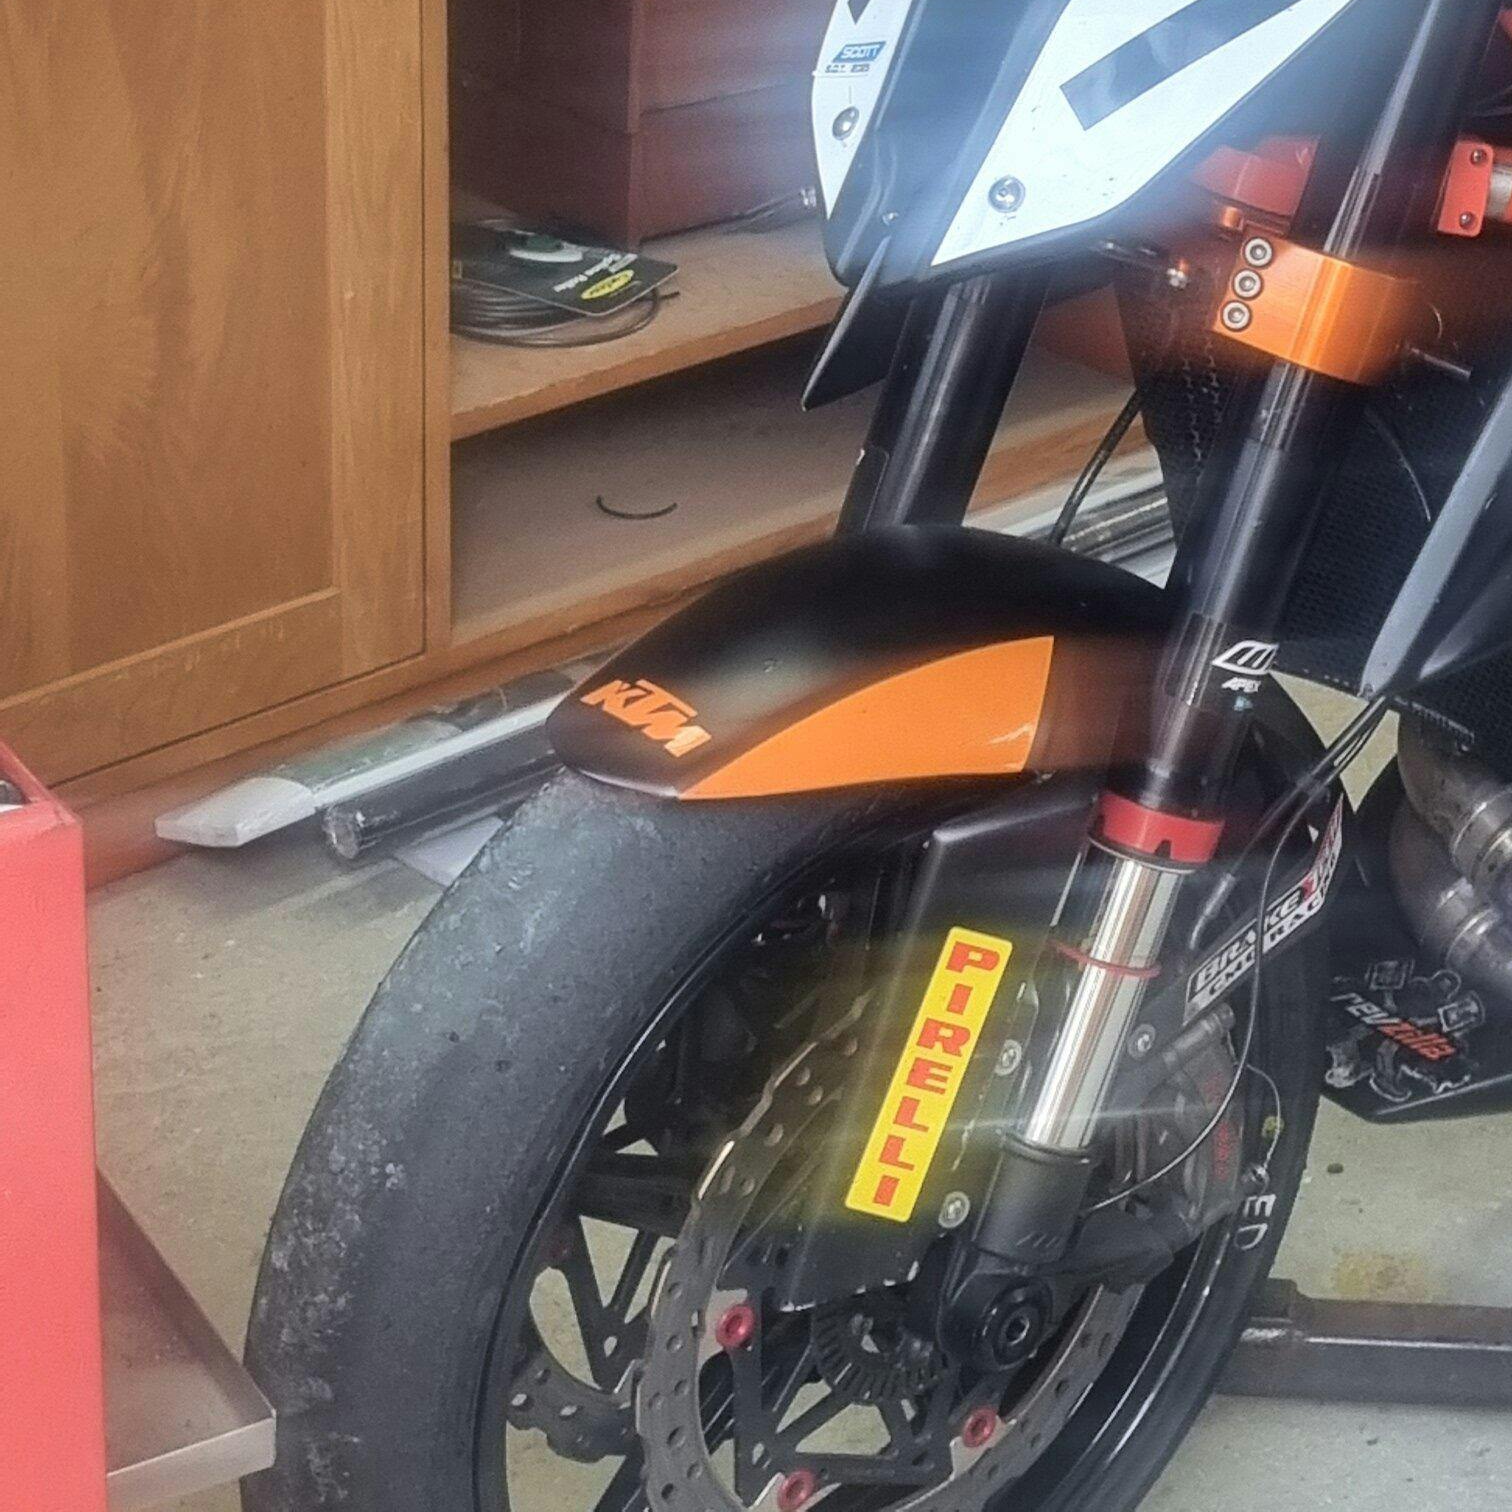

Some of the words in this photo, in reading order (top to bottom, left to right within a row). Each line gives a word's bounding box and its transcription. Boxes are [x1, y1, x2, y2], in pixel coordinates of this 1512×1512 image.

[579, 678, 713, 758] KTM
[1221, 677, 1262, 693] APEX
[873, 940, 997, 1206] PIRELLI
